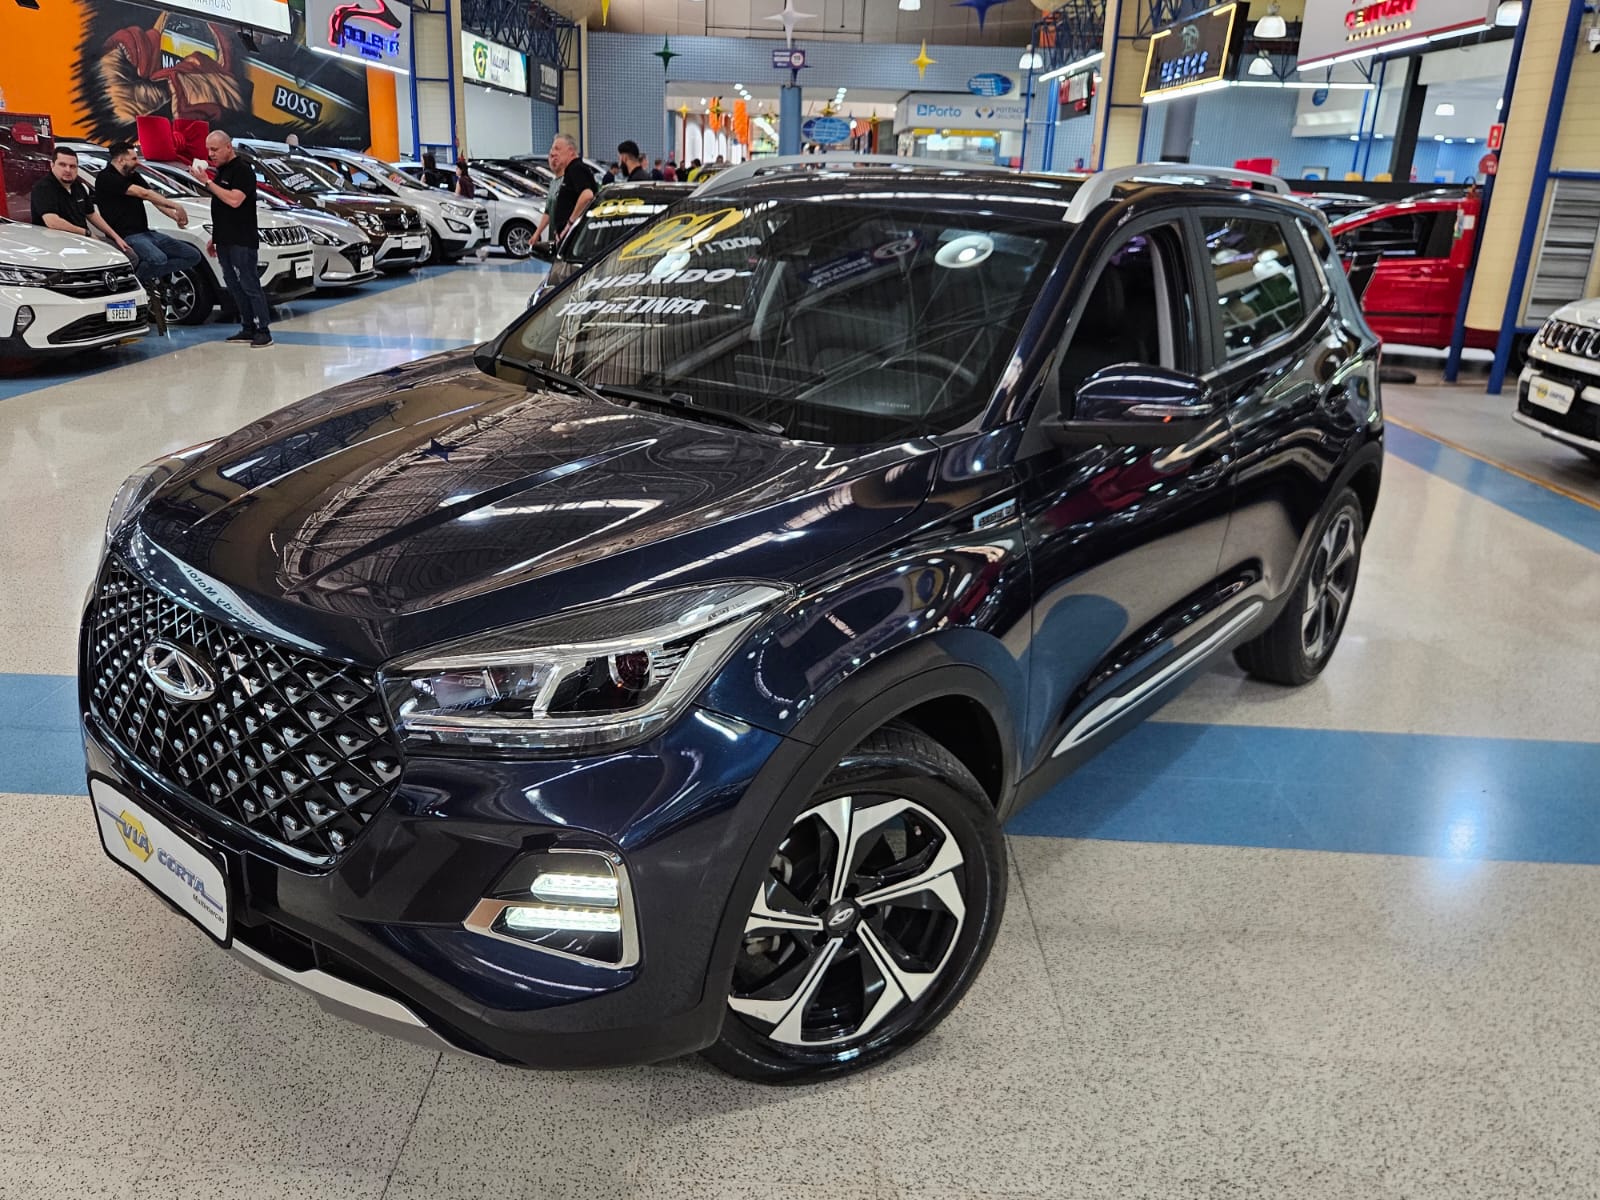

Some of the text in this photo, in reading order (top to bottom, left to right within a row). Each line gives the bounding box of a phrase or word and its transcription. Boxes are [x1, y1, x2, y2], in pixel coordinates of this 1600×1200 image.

[275, 87, 319, 119] BOSS
[928, 104, 961, 117] Porto
[556, 300, 606, 317] TOP
[121, 821, 205, 896] VIA CERTA
